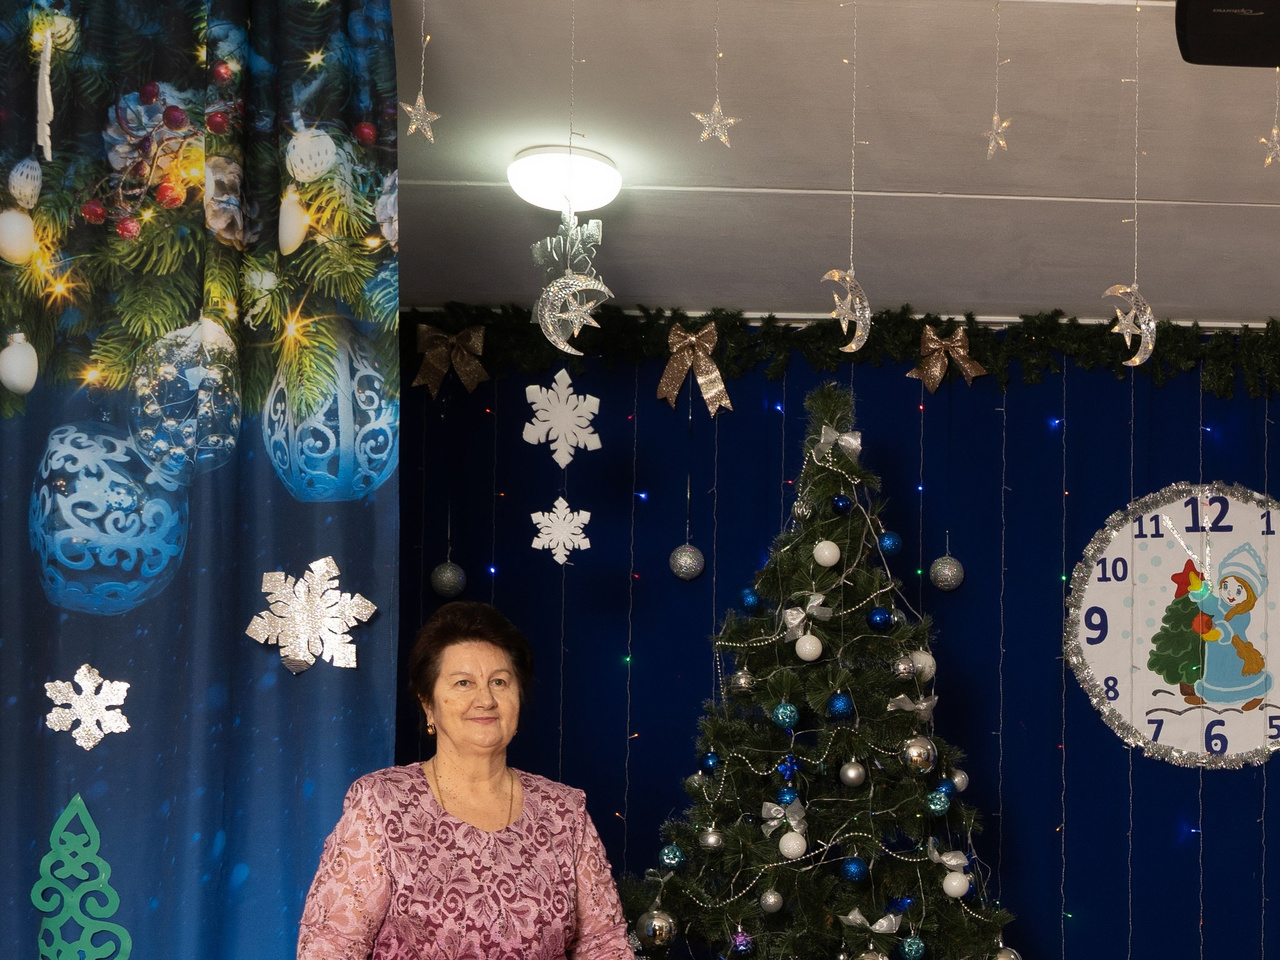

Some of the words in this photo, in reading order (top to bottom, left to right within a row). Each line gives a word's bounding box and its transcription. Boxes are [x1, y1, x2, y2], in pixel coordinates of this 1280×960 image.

[1133, 515, 1164, 538] 11
[1184, 496, 1233, 532] 12
[1260, 511, 1275, 535] 1
[1096, 557, 1128, 582] 10
[1084, 606, 1108, 644] 9
[1103, 676, 1119, 701] 8
[1147, 719, 1164, 742] 7
[1204, 719, 1228, 754] 6
